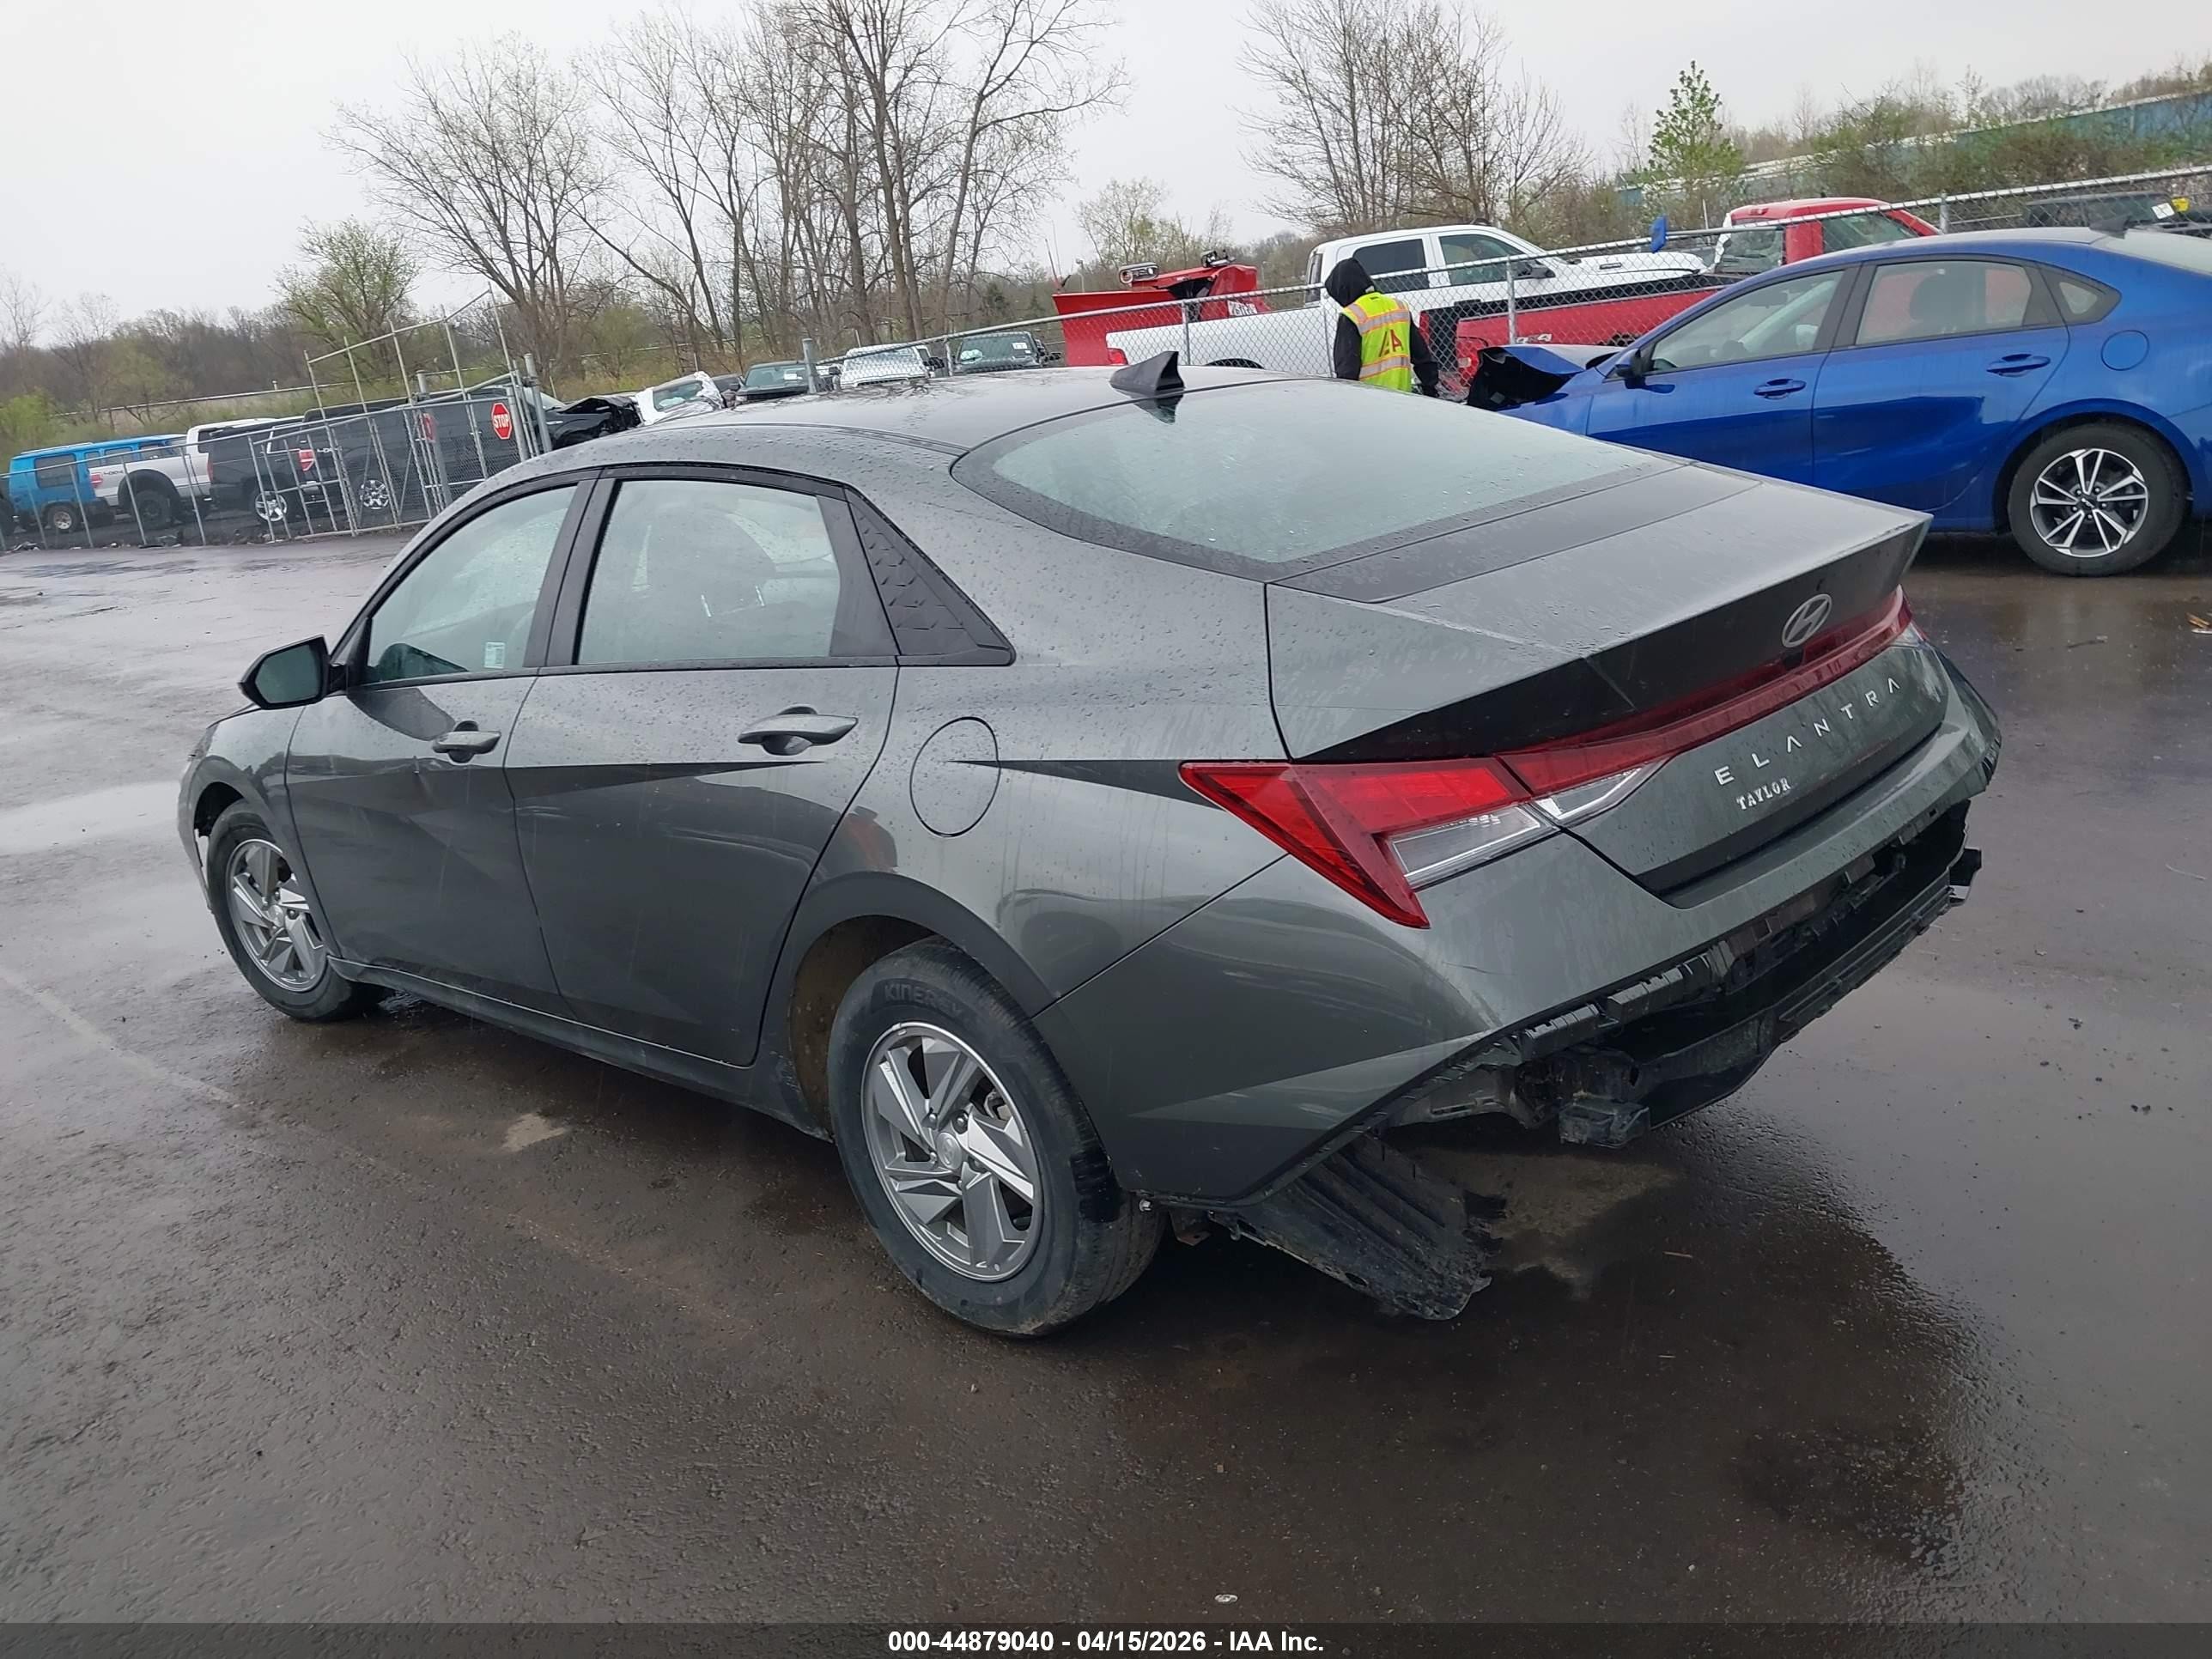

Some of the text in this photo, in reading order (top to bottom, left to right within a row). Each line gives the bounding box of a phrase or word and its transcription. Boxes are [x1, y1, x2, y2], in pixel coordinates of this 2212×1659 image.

[493, 413, 509, 428] STOP
[1714, 677, 1900, 786] ELANTRA
[1736, 777, 1791, 810] TAYLOR
